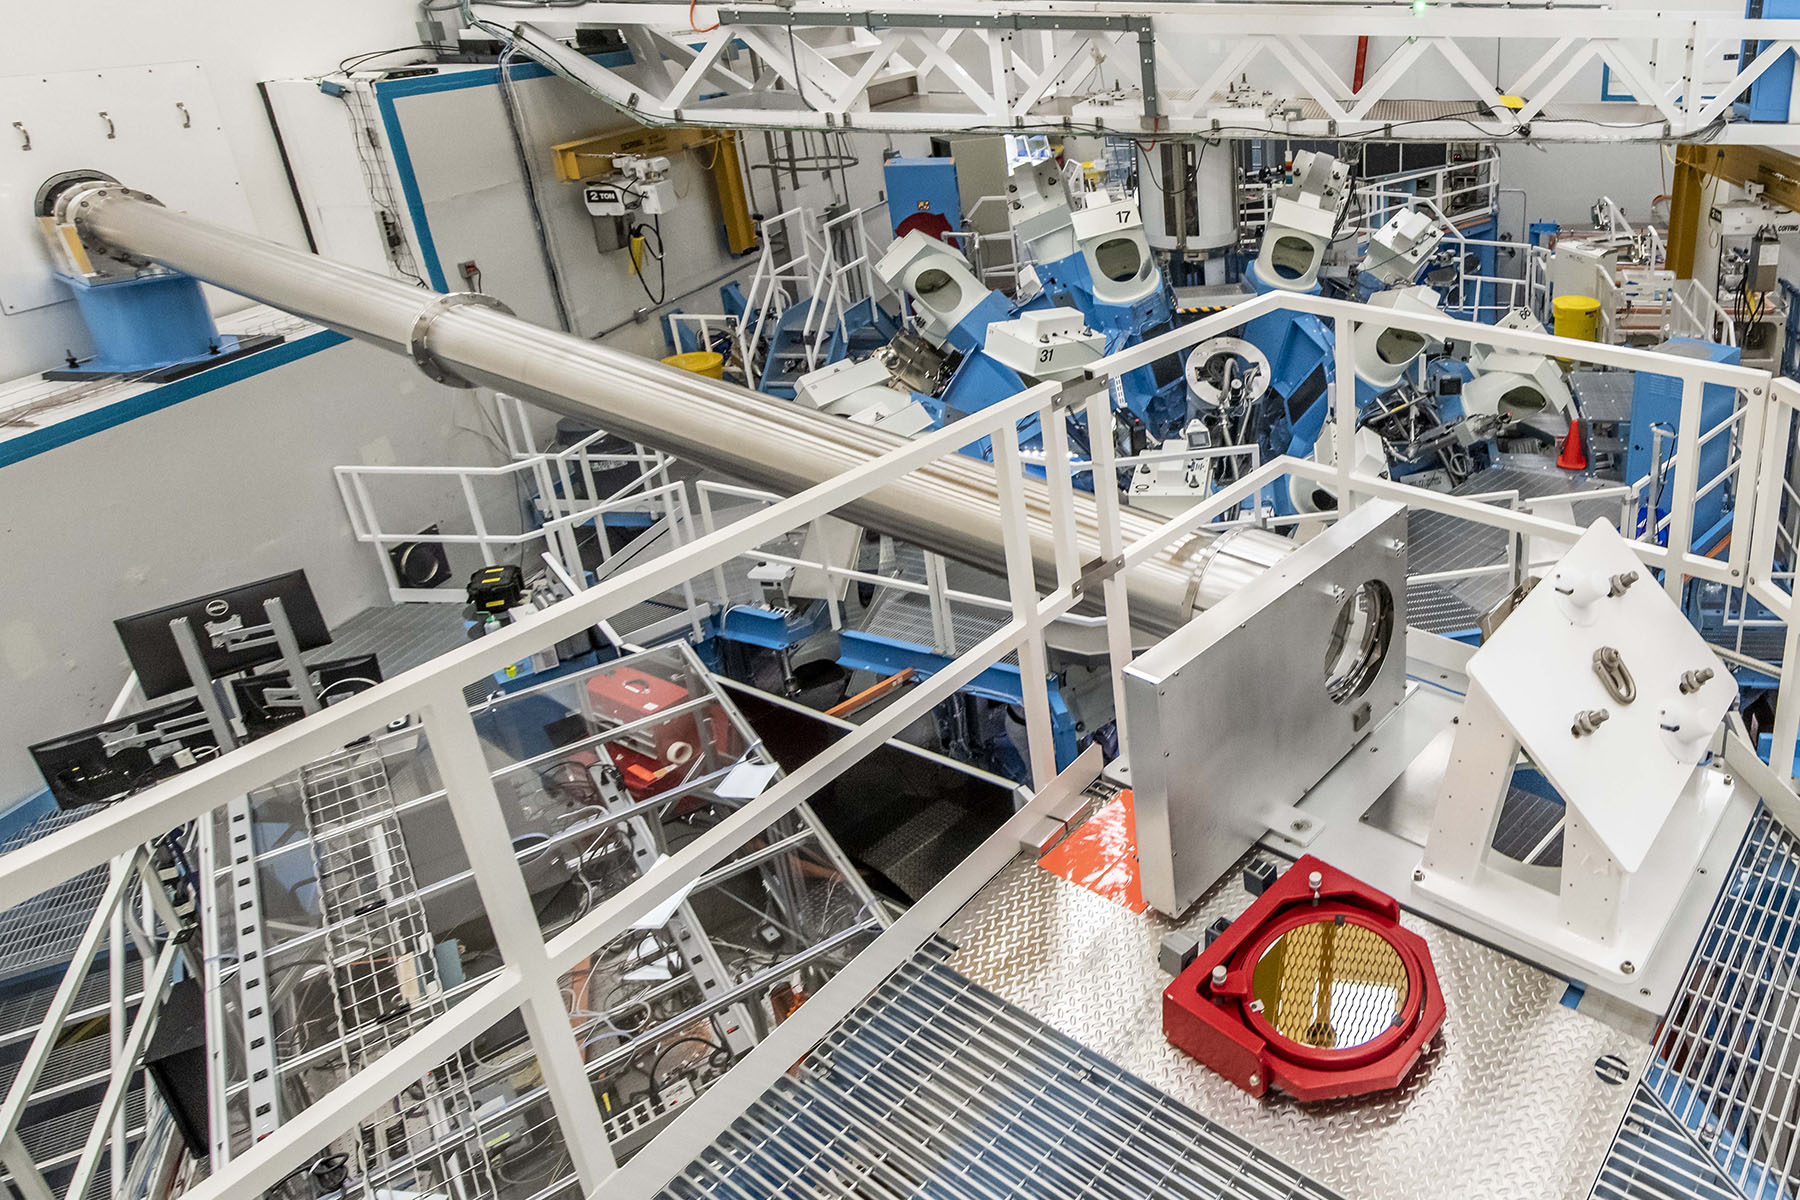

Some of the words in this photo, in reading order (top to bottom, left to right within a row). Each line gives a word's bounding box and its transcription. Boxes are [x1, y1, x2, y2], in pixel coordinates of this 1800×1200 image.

[590, 191, 599, 201] 2
[599, 192, 615, 200] TON
[1115, 210, 1131, 224] 17
[1039, 348, 1054, 363] 31
